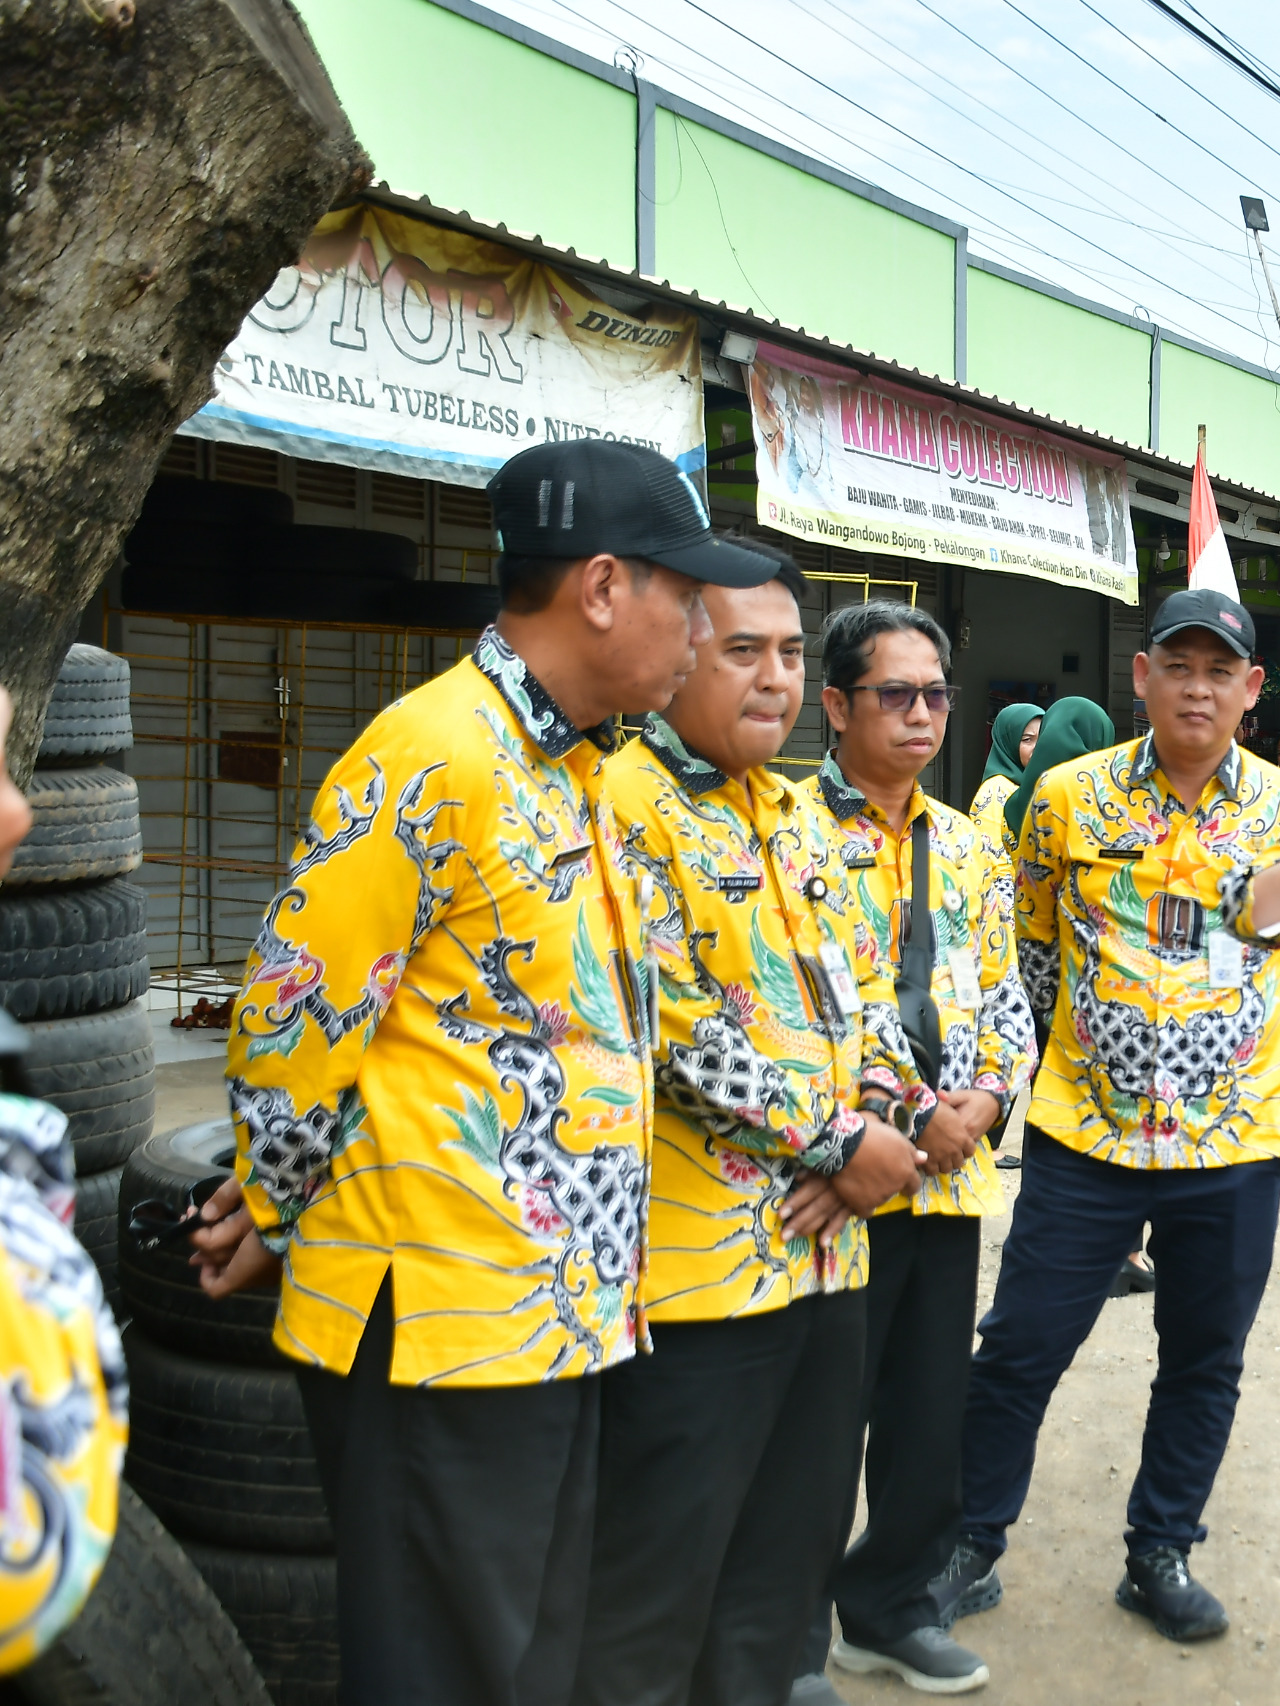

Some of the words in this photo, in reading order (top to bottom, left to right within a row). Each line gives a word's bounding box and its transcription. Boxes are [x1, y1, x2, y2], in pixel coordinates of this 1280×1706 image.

[576, 310, 681, 348] DUNLOP
[245, 353, 375, 409] TAMBAL
[383, 383, 519, 437] TUBELESS
[839, 381, 940, 474] KHANA
[939, 412, 1073, 507] COLECTION
[847, 486, 867, 504] BAJU
[868, 490, 899, 510] WANITA
[902, 497, 928, 516] GAMIS
[932, 503, 955, 521] JILBAB
[991, 516, 1009, 532] BAJU
[790, 511, 814, 533] Raya
[816, 518, 889, 544] Wangandowo
[892, 530, 926, 553] Bojong
[1000, 549, 1027, 566] Khana
